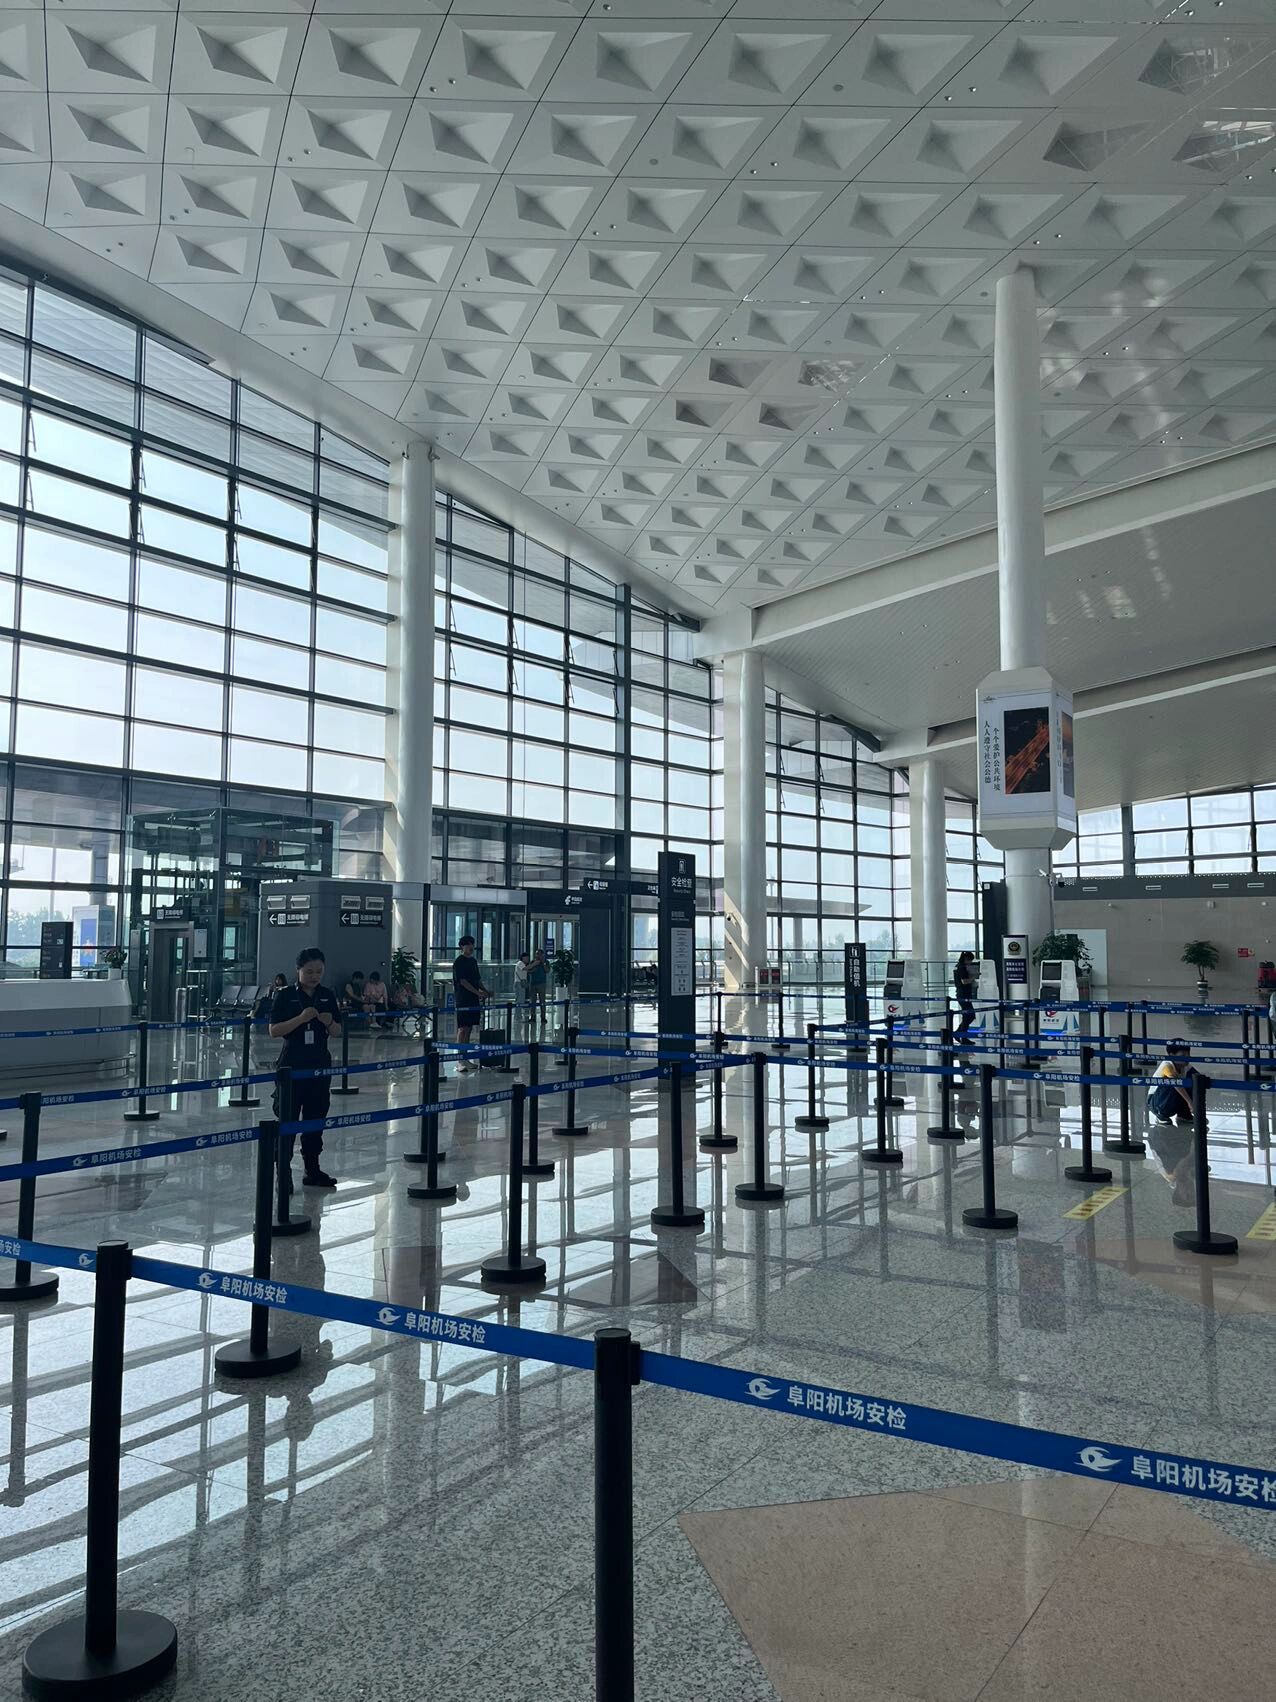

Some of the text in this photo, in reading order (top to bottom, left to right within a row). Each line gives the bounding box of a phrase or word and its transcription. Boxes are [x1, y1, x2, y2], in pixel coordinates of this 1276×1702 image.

[1045, 1073, 1080, 1081] 阜阳机场安检
[1144, 1078, 1183, 1086] 阜阳机场安检
[337, 1113, 372, 1126] 阜阳机场安检
[211, 1129, 253, 1144] 阜阳机场安检
[91, 1148, 142, 1164] 阜阳机场安检
[220, 1276, 288, 1304] 阜阳机场安检
[404, 1311, 487, 1344] 阜阳机场安检
[787, 1385, 907, 1430] 阜阳机场安检
[1131, 1455, 1276, 1503] 阜阳机场安检
